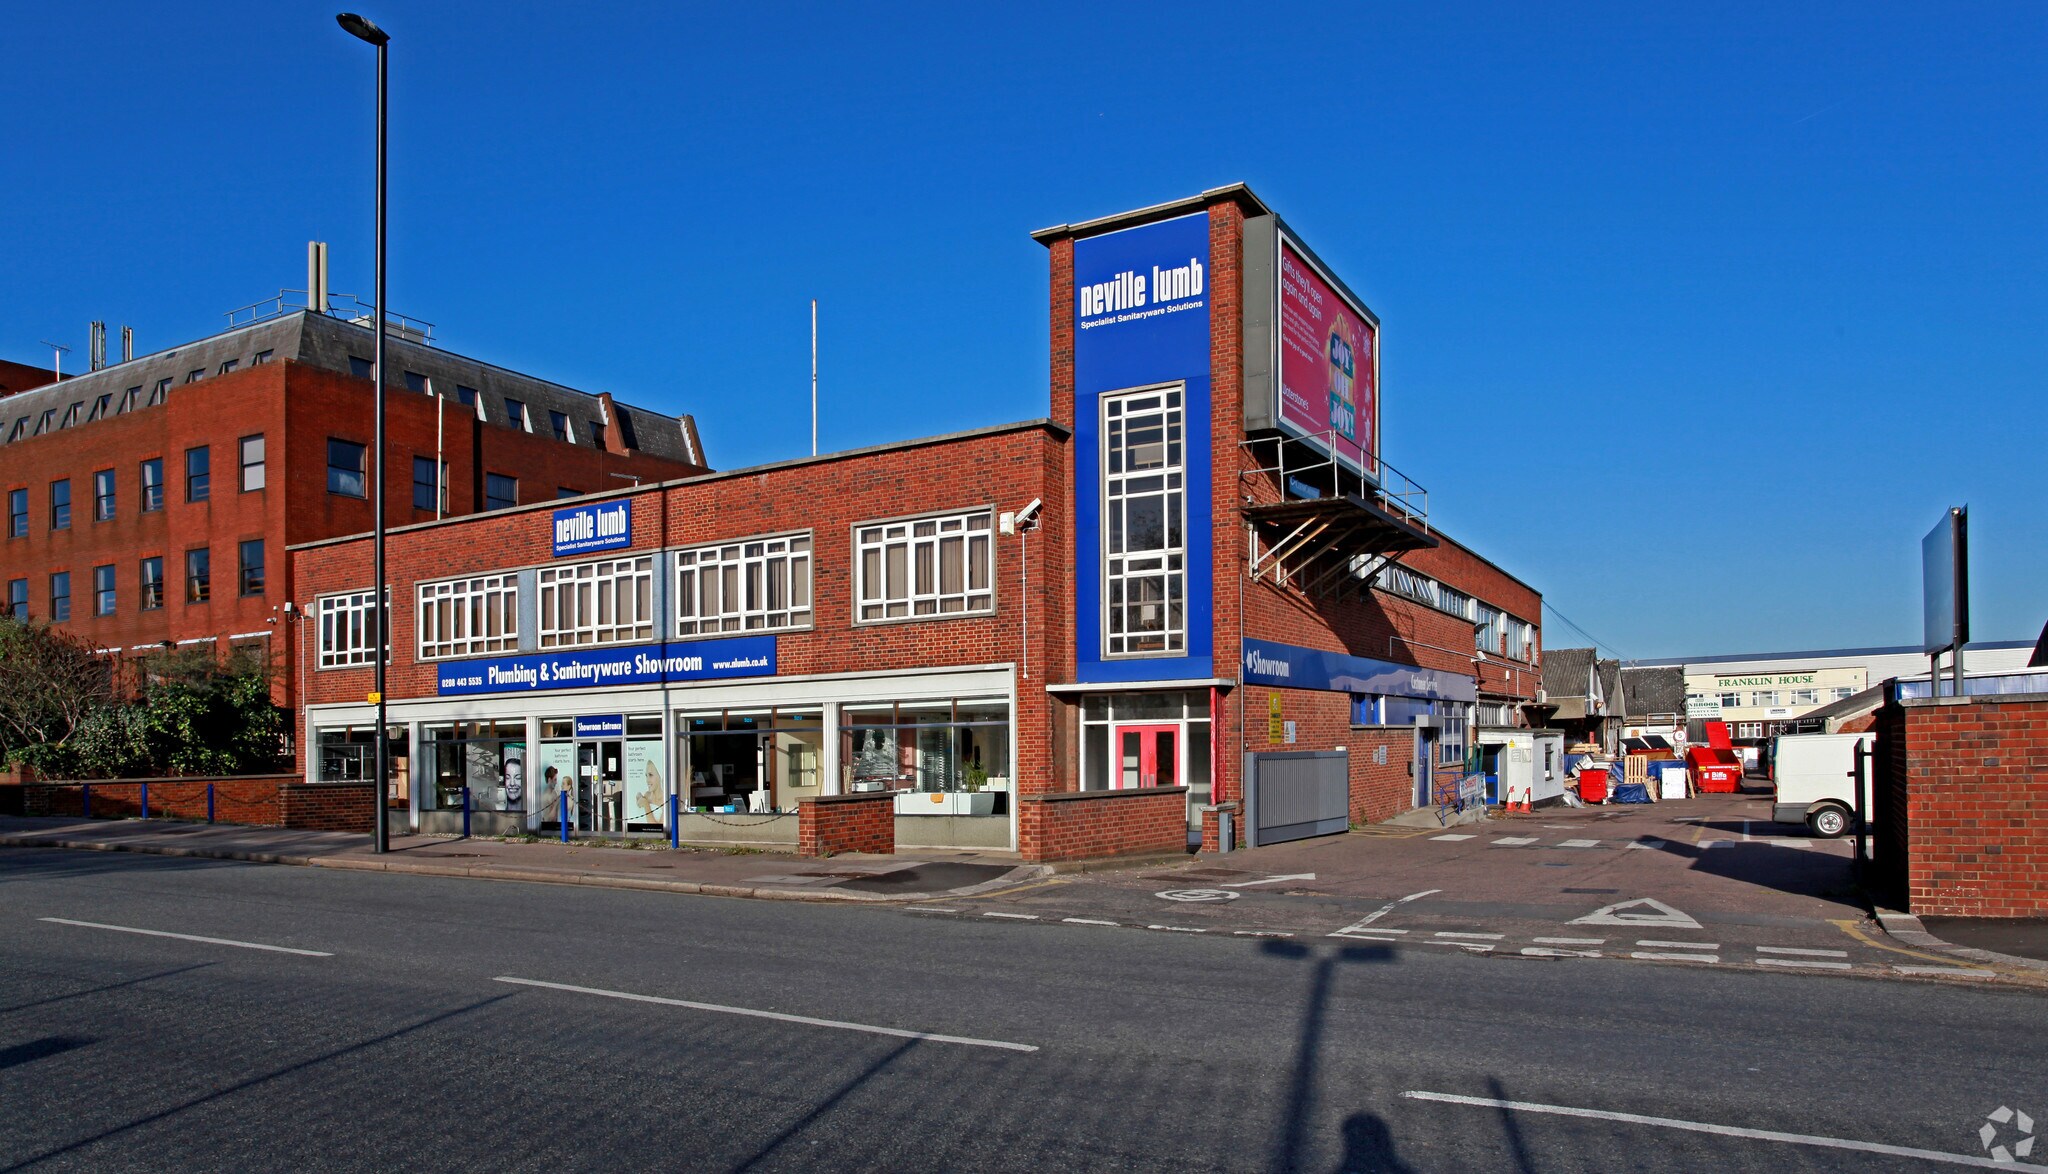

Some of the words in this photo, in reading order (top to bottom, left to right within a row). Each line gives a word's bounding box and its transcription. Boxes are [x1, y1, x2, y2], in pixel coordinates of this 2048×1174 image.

[1081, 270, 1146, 317] neville
[1153, 258, 1203, 303] lumb
[1298, 292, 1308, 308] and
[1081, 316, 1116, 330] Specialist
[1117, 307, 1165, 322] Sanitaryware
[1166, 300, 1203, 313] Solutions
[1332, 338, 1351, 370] JOY
[1331, 400, 1354, 435] JOY!
[556, 511, 594, 543] neville
[597, 505, 626, 537] lumb
[556, 543, 577, 552] Specialist
[605, 536, 626, 544] Solutions
[457, 677, 467, 687] 443
[468, 676, 483, 686] 5535
[488, 664, 537, 687] Plumbing
[540, 663, 549, 681] &
[552, 661, 631, 683] Sanitaryware
[635, 653, 703, 674] Showroom
[712, 656, 768, 670] www.nlumb.co.uk
[1253, 650, 1289, 678] Showroom
[1718, 677, 1772, 687] FRANKLIN
[1779, 675, 1814, 685] HOUSE
[578, 722, 601, 731] Showroom
[602, 721, 622, 730] Entrance
